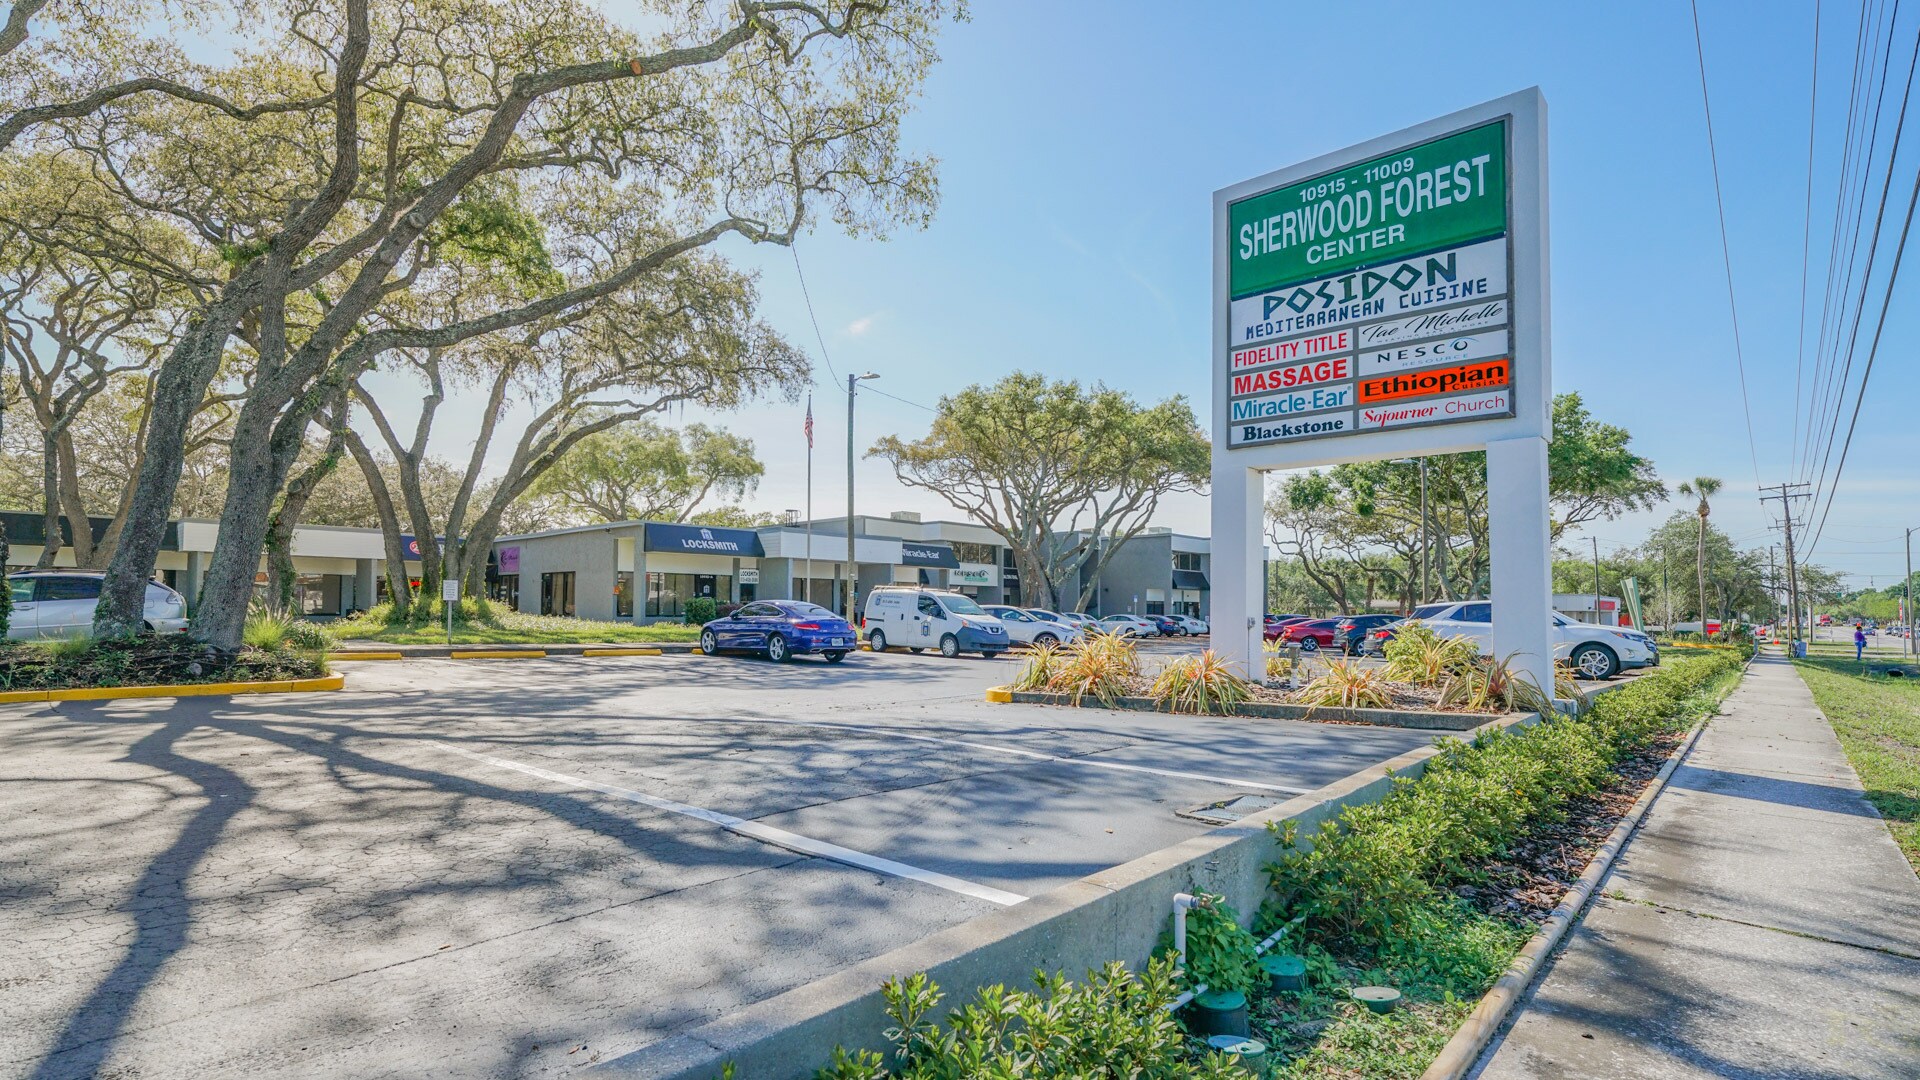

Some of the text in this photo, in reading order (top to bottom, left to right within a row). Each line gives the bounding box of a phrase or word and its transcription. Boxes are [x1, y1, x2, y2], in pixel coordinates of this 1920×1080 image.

[1299, 177, 1346, 203] 10915
[1363, 157, 1415, 184] 11009
[1239, 153, 1490, 261] SHERWOOD FOREST
[1306, 223, 1405, 265] CENTER
[1263, 252, 1457, 321] POSIDON
[1245, 277, 1488, 341] MEDITERRANEAN CUISINE
[1362, 302, 1504, 343] Tae Michelle
[1234, 332, 1347, 368] FIDELITY TITLE
[1377, 340, 1468, 364] NESCO
[1402, 353, 1469, 367] RESOURCE
[1234, 358, 1347, 395] MASSAGE
[1364, 365, 1504, 397] Ethiopian
[1452, 378, 1504, 391] Cuisine
[1363, 395, 1505, 428] Sojourner Church
[1243, 419, 1344, 442] Blackstone
[681, 538, 739, 552] LOCKSMITH
